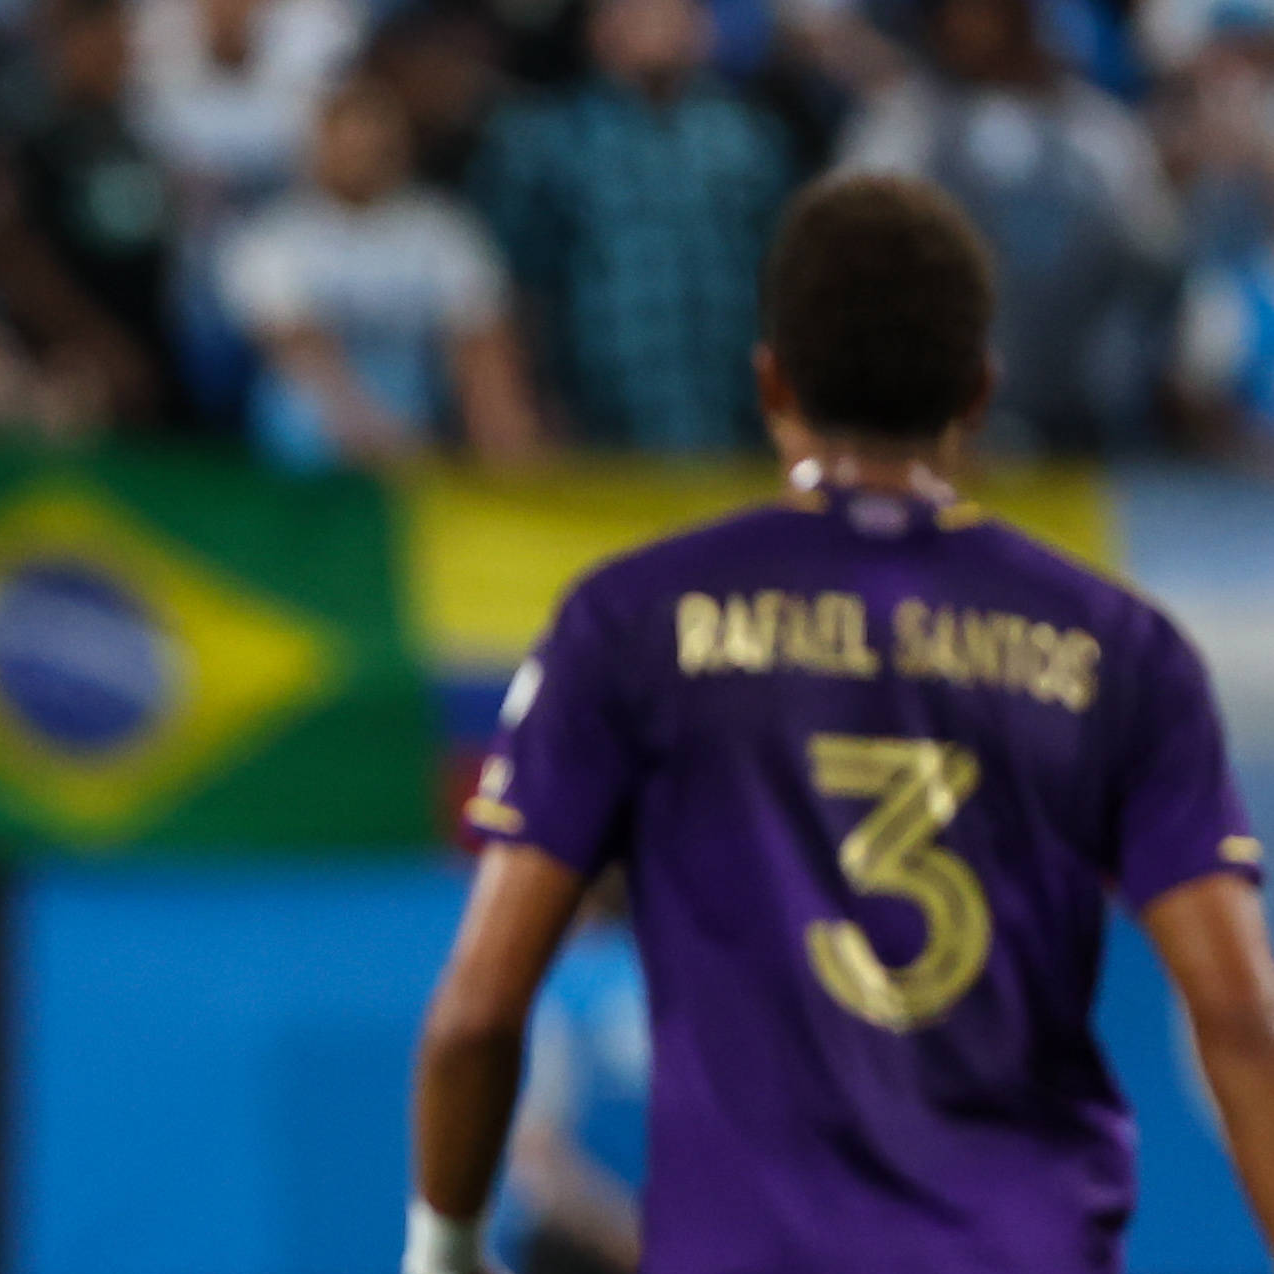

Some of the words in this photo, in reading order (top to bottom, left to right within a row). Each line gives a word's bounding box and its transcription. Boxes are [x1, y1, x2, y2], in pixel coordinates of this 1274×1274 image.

[676, 590, 878, 678] RAFAEL
[893, 597, 1102, 713] SANTOS
[805, 733, 991, 1034] 3
